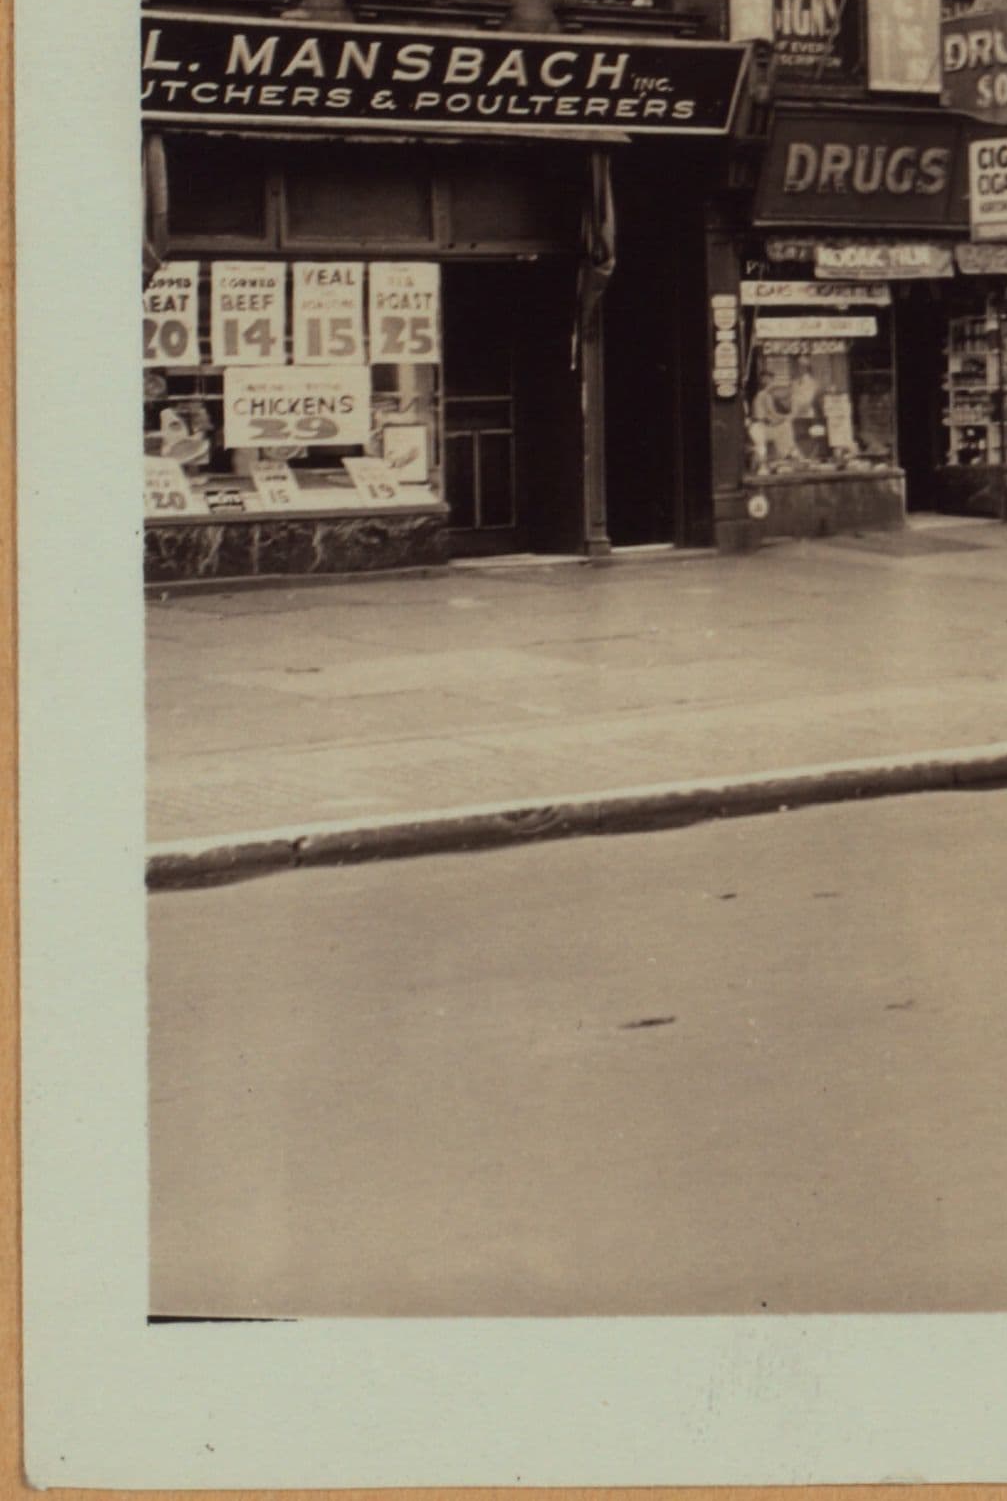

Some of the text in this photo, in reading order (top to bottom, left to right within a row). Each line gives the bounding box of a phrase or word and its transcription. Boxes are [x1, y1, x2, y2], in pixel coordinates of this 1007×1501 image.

[142, 29, 200, 71] L.
[225, 34, 629, 90] MANSBACH
[142, 79, 695, 119] UTCHERS & POULTERERS
[783, 142, 950, 195] DRUGS
[303, 269, 355, 285] VEAL
[220, 294, 274, 311] BEEF
[376, 292, 432, 309] ROAST
[223, 318, 276, 356] 14
[306, 318, 355, 356] 15
[380, 316, 432, 354] 25
[232, 395, 353, 415] CHICKENS
[248, 418, 339, 440] 29
